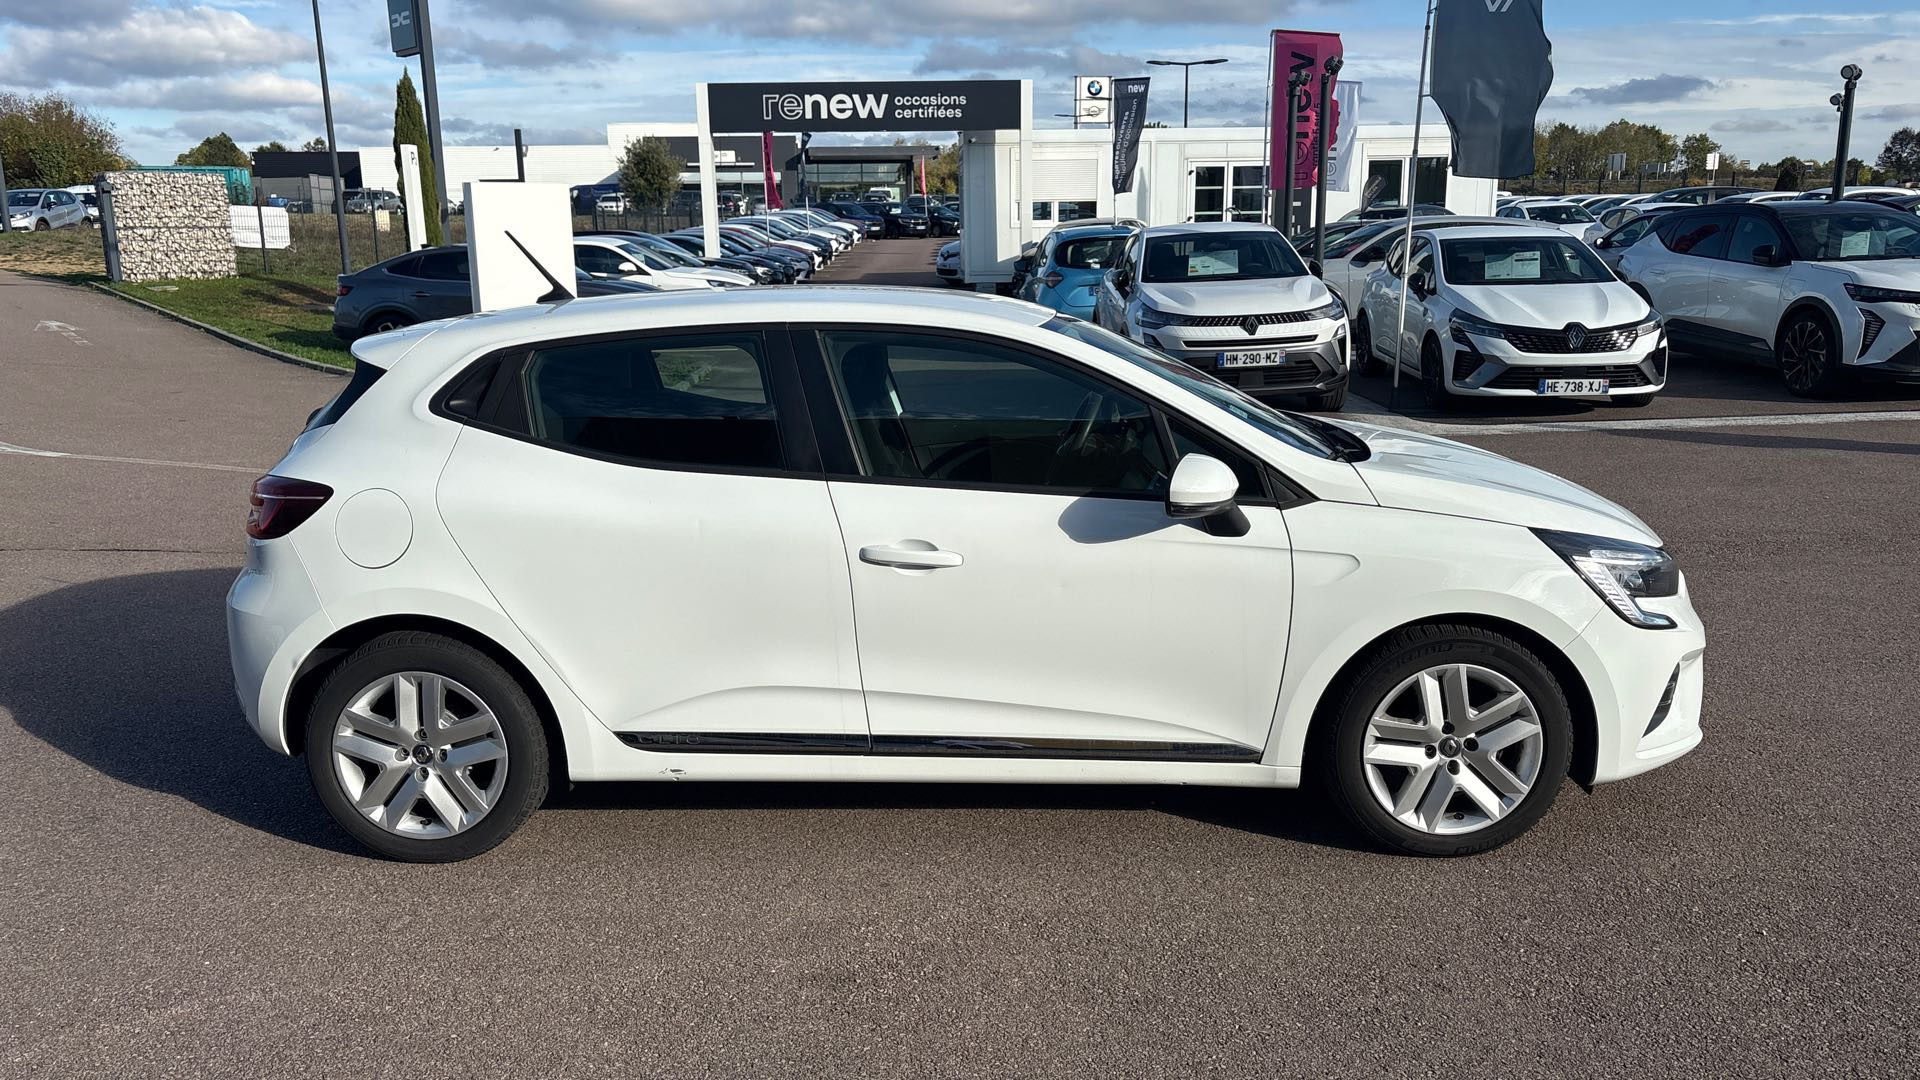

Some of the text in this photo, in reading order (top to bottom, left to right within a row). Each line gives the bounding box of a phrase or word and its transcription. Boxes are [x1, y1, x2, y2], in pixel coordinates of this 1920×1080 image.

[894, 93, 967, 105] occasions
[762, 93, 889, 120] renew
[894, 106, 963, 118] certifiées
[1225, 352, 1278, 365] HM-290-MZ
[1546, 381, 1602, 393] HE-738-XJ
